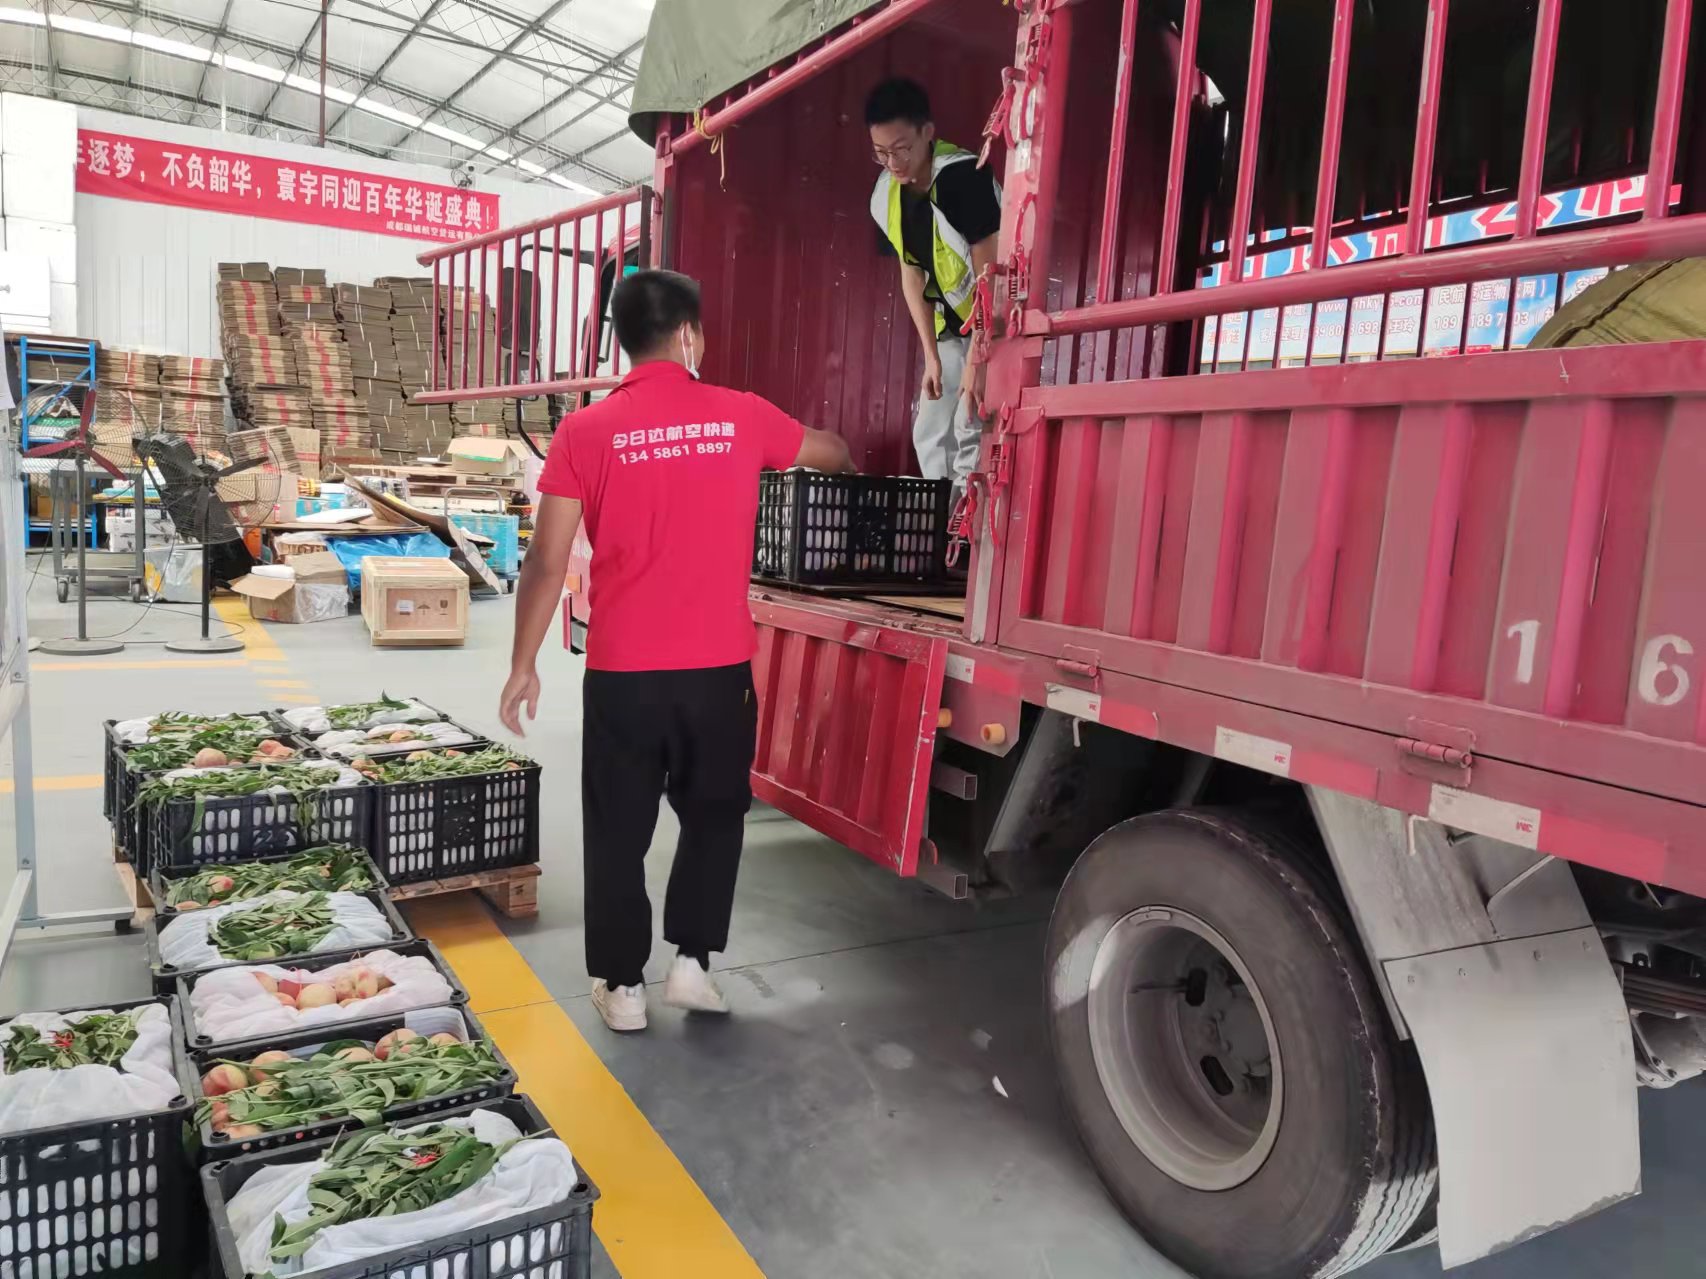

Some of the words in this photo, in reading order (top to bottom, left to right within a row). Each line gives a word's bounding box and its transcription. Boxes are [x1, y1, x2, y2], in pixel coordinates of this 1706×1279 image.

[612, 422, 735, 448] 今日达航空快递
[619, 450, 649, 465] 134
[653, 444, 690, 459] 5861
[696, 442, 732, 455] 8897
[1507, 619, 1541, 684] 1
[1637, 633, 1694, 706] 6
